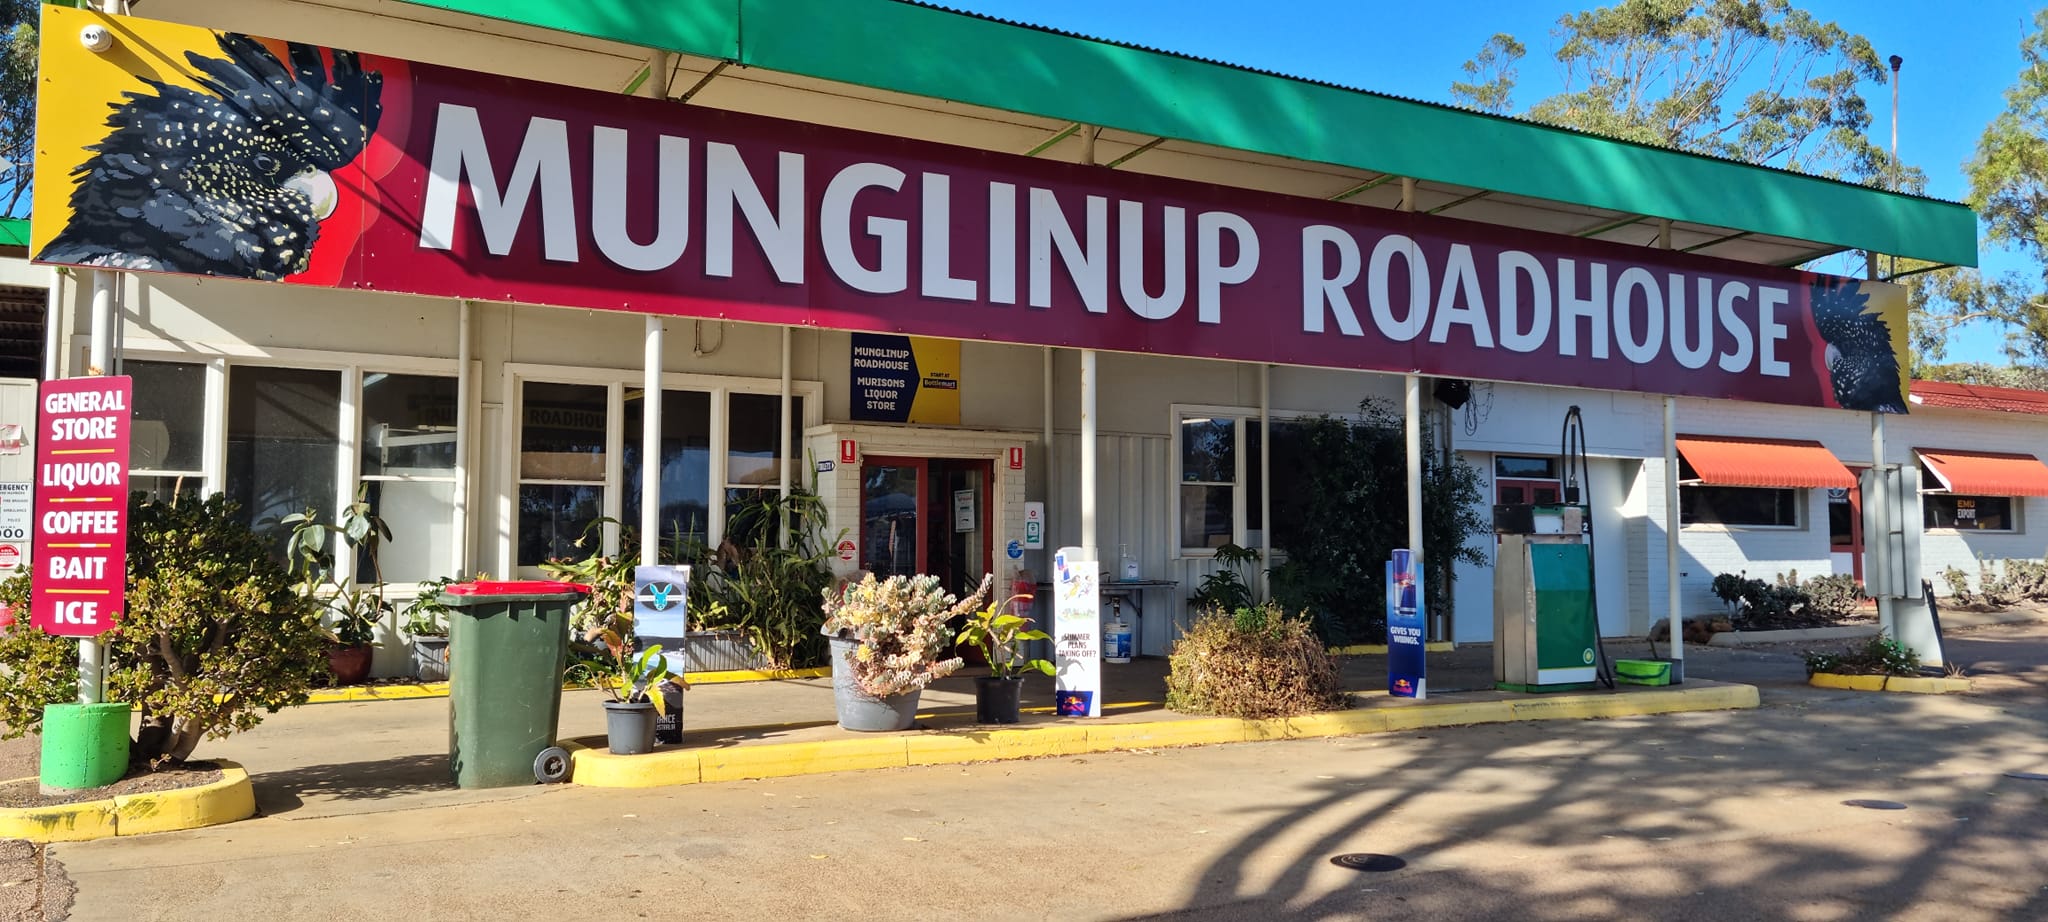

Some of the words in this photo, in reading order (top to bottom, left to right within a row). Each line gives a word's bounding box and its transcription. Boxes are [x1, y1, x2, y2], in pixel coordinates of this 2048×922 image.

[419, 102, 1261, 324] MUNGLINUP
[1302, 224, 1791, 377] ROADHOUSE
[854, 347, 910, 359] MUNGLINUP
[854, 358, 910, 371] ROADHOUSE
[857, 377, 905, 388] MURISONS
[864, 388, 898, 400] LIQUOR
[45, 390, 126, 414] GENERAL
[867, 400, 896, 411] STORE
[530, 409, 605, 428] ROADHOU
[51, 416, 117, 441] STORE
[43, 461, 121, 491] LIQUOR
[1957, 499, 1975, 508] EMU
[43, 510, 119, 534] COFFEE
[1583, 523, 1589, 531] 2
[49, 556, 107, 580] BAIT
[55, 601, 98, 625] ICE
[1064, 633, 1090, 641] SUMMER
[1391, 626, 1407, 635] GIVES
[1408, 628, 1421, 636] YOU
[1068, 641, 1087, 649] PLANS
[1058, 649, 1081, 658] TAKING
[1082, 650, 1097, 658] OFF?
